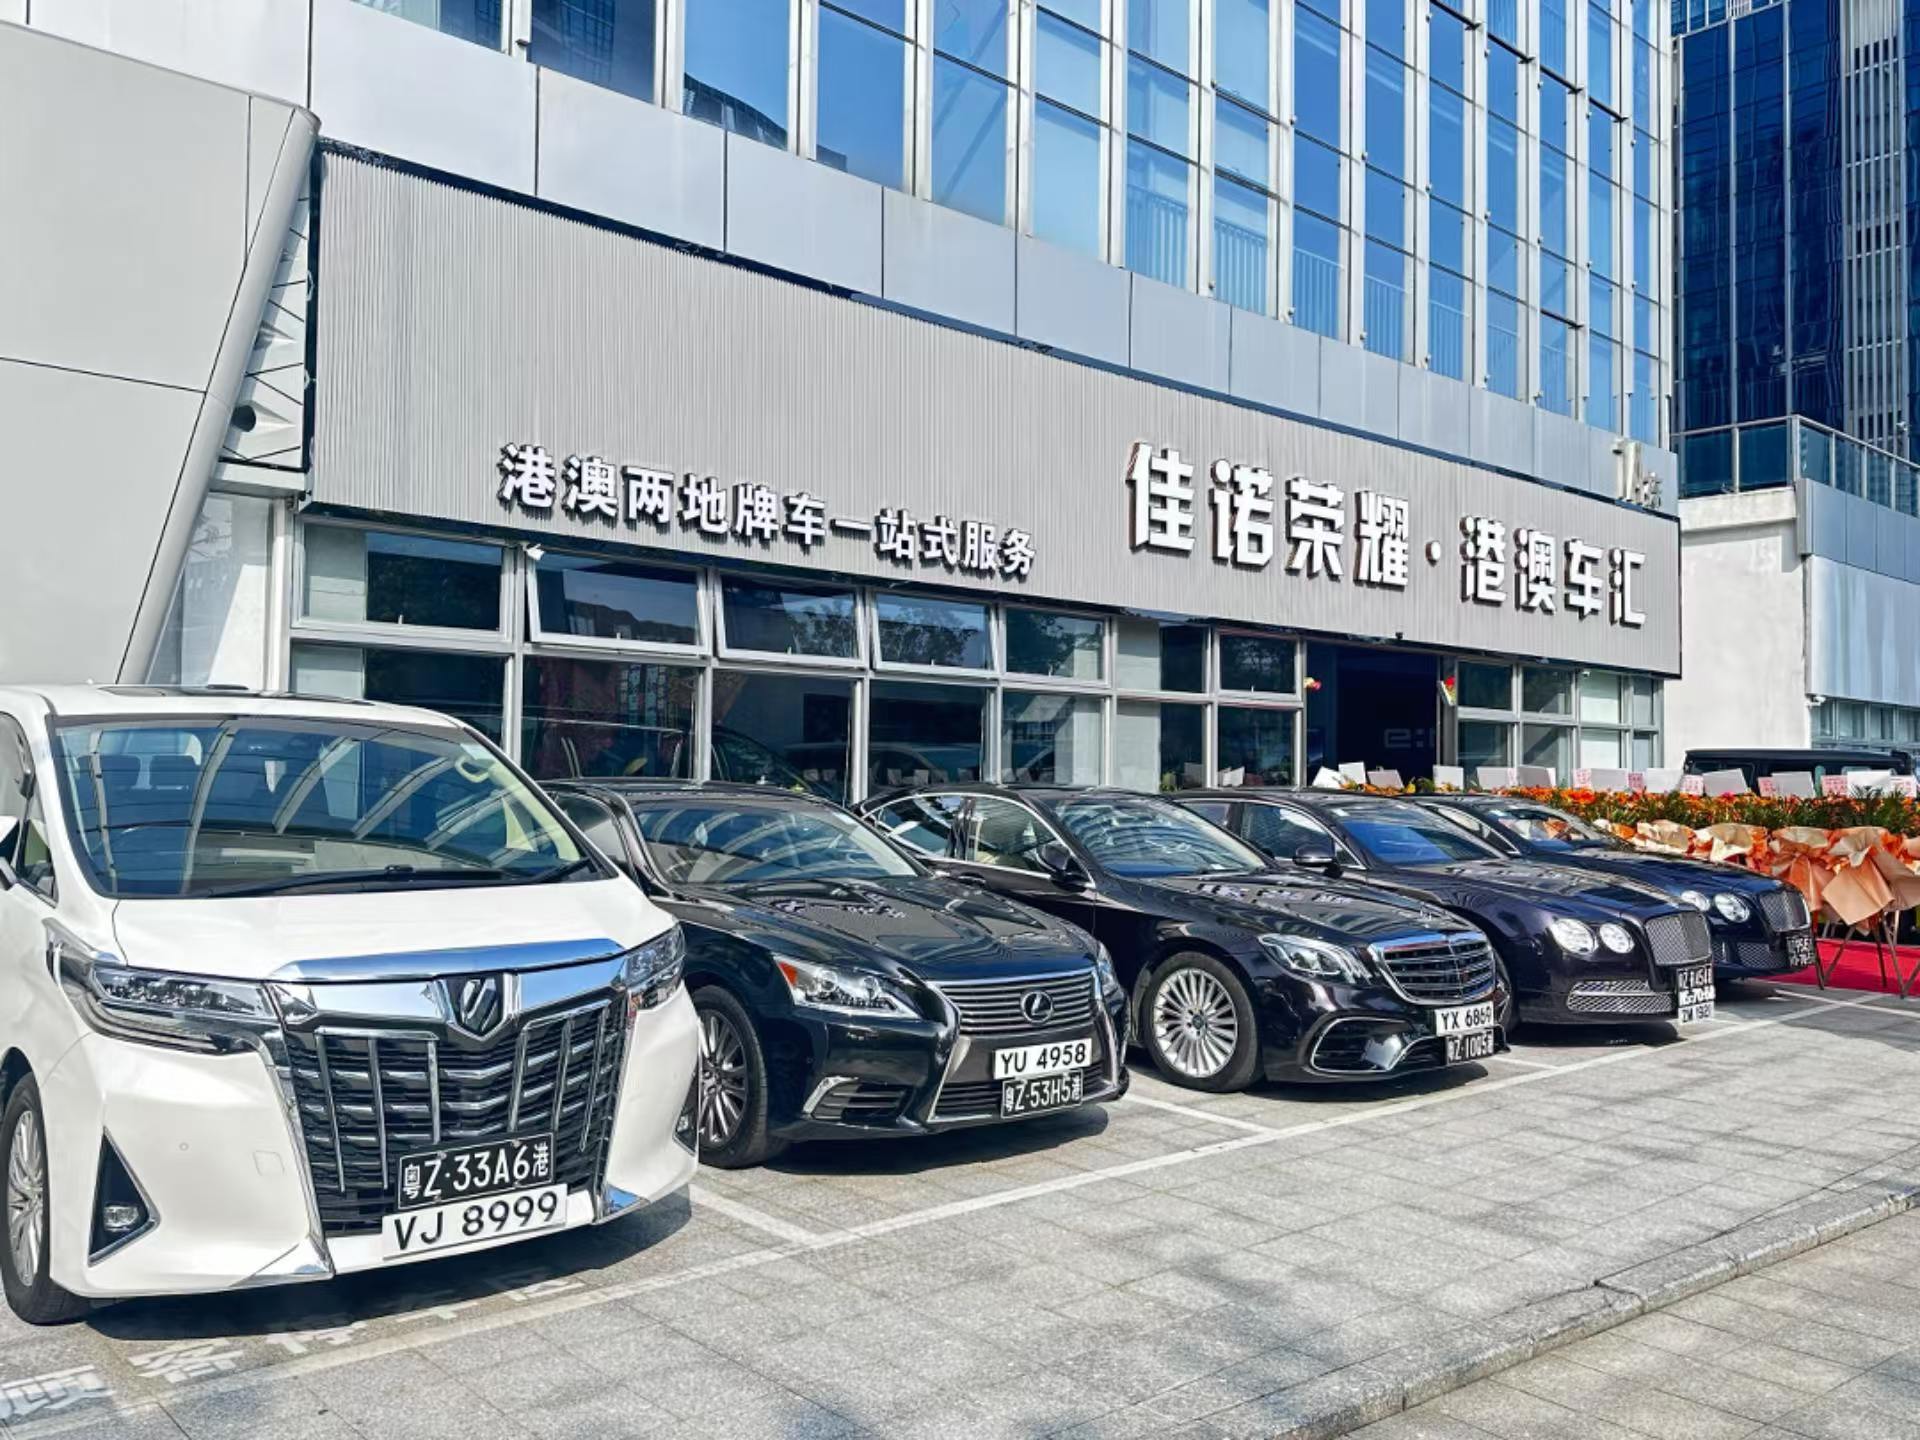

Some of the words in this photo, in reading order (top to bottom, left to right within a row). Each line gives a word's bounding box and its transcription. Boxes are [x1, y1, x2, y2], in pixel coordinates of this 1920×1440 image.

[498, 442, 1037, 577] 港澳两地牌车一站式服务
[1126, 442, 1647, 626] 佳诺荣耀·港澳车汇
[1441, 1011, 1460, 1031] YX
[1001, 1050, 1027, 1075] YU
[1036, 1043, 1086, 1070] 4958
[394, 1211, 443, 1250] VJ
[462, 1191, 557, 1236] 8999
